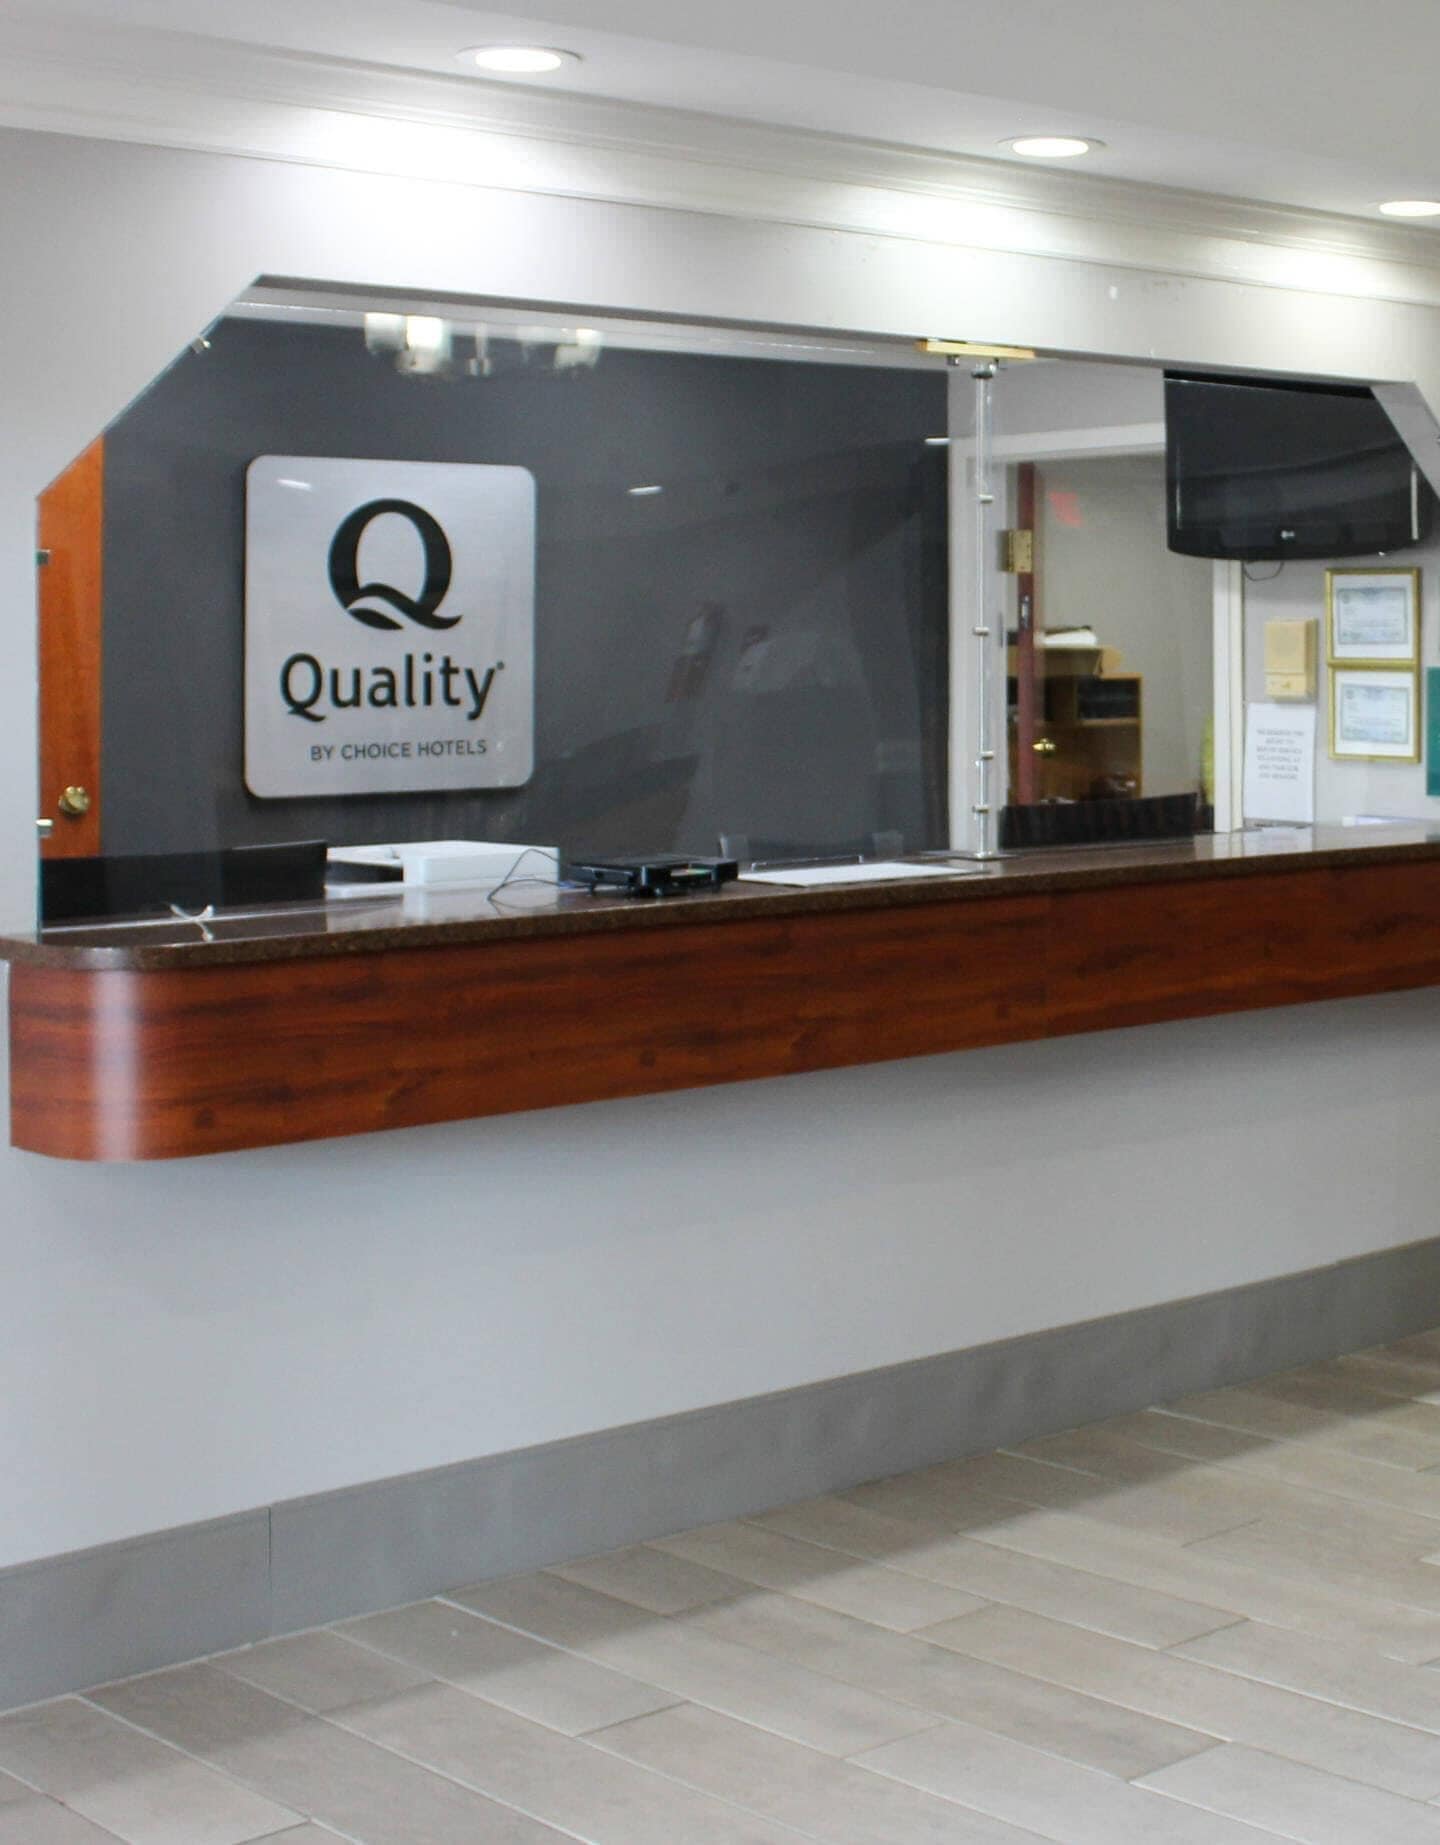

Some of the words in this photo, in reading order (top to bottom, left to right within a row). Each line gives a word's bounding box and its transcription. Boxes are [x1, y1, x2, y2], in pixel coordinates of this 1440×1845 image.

[327, 497, 462, 631] Q
[280, 652, 496, 722] Quality
[310, 745, 333, 761] BY
[340, 743, 411, 760] CHOICE
[417, 739, 488, 758] HOTELS
